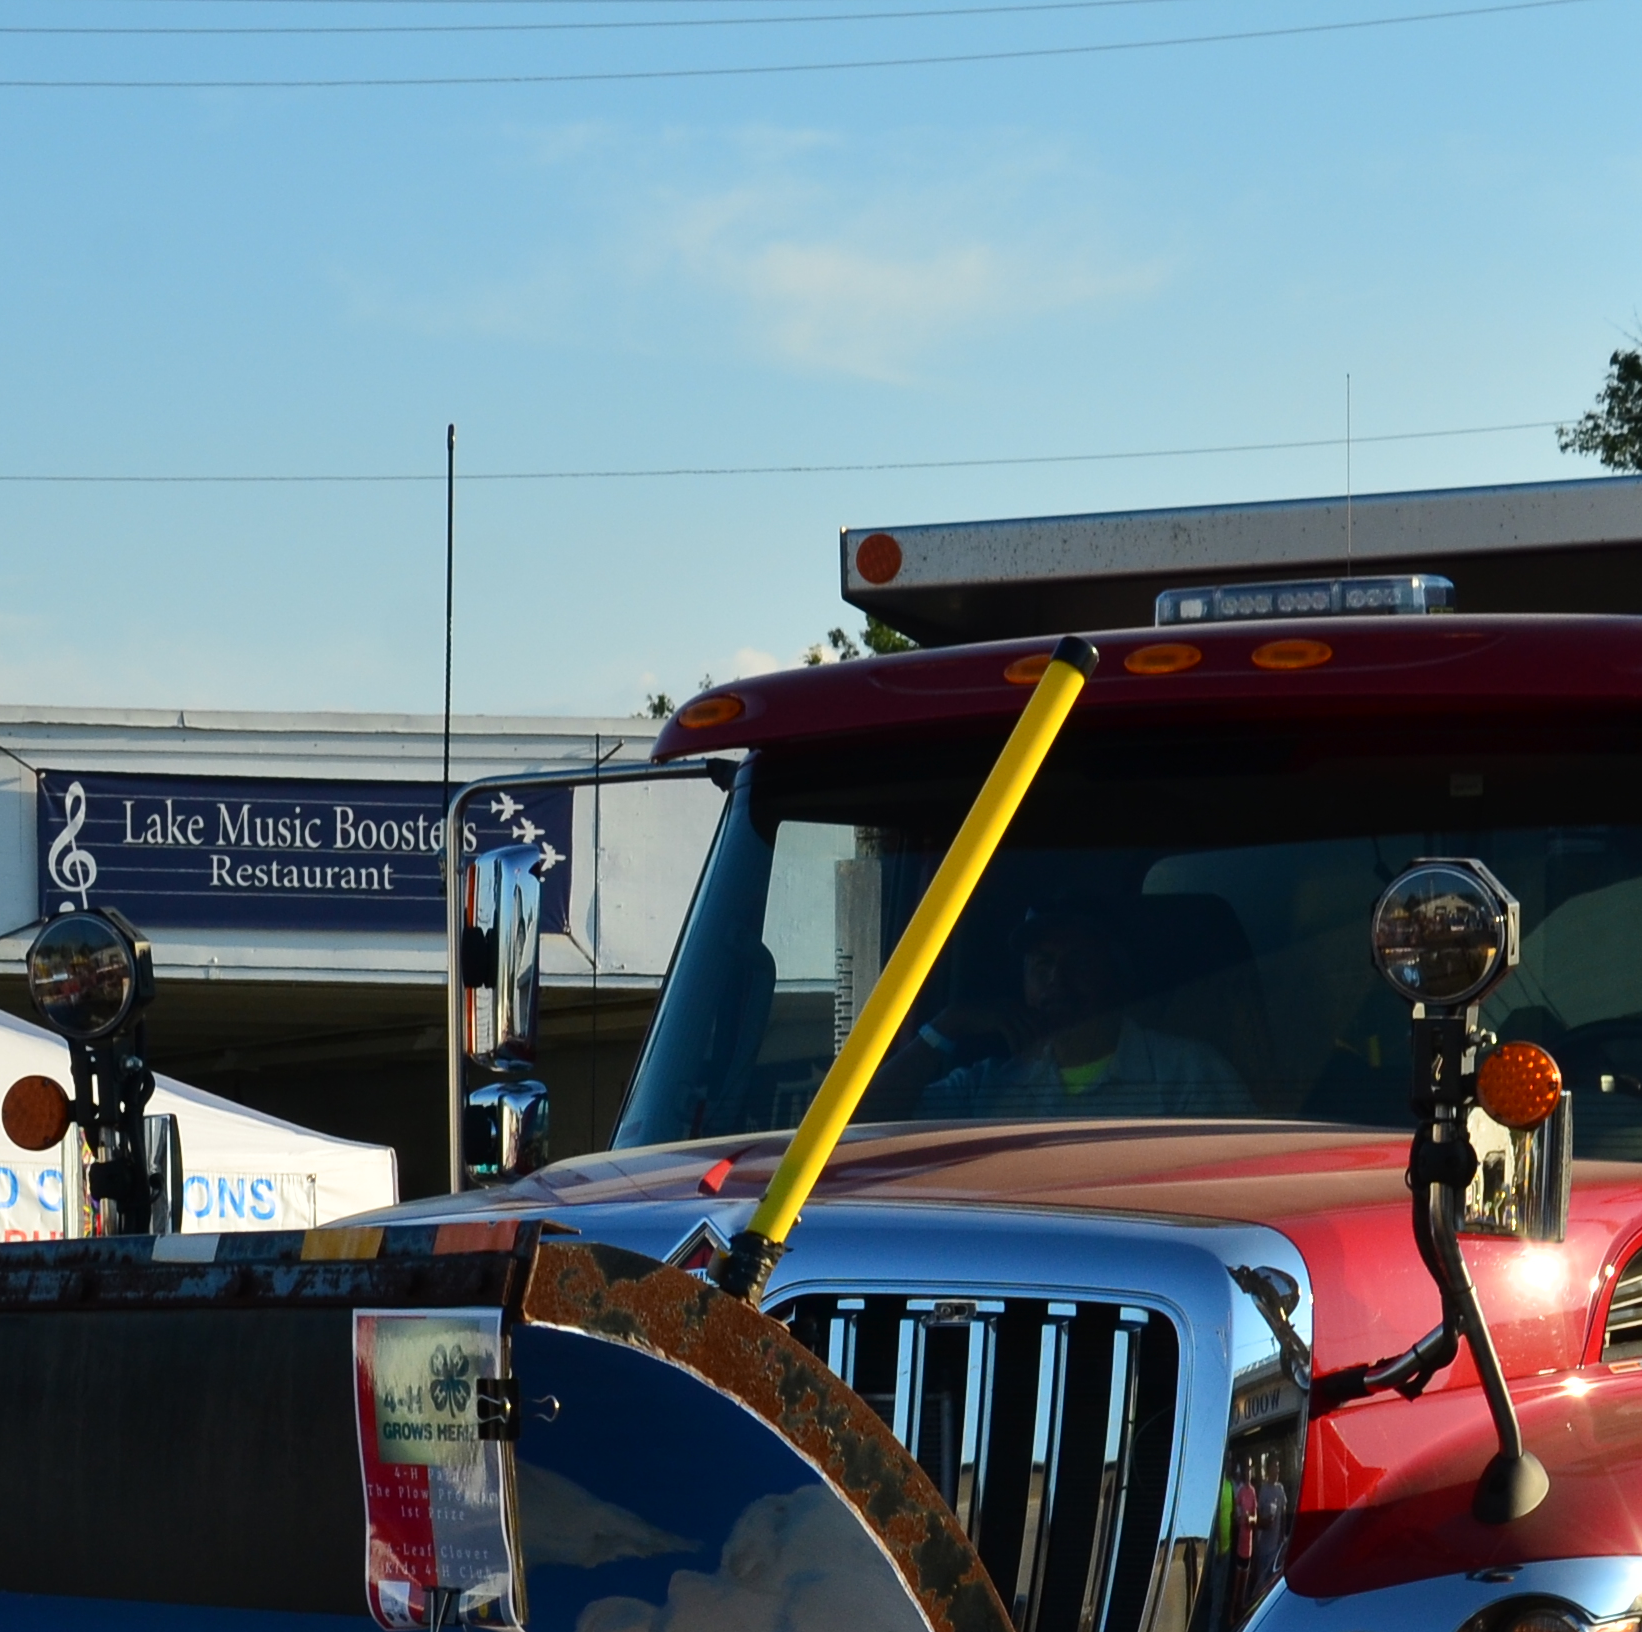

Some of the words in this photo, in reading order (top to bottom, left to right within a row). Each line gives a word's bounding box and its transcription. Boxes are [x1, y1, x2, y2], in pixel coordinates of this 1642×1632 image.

[122, 799, 204, 846] Lake
[216, 803, 323, 851] Music
[333, 806, 477, 854] Boostes
[209, 854, 395, 891] Restaurant
[37, 1168, 276, 1221] CONS
[383, 1422, 433, 1441] GROWS
[367, 1484, 390, 1498] The
[398, 1486, 430, 1499] Plow
[428, 1507, 465, 1521] Prize
[440, 1544, 489, 1560] Clover
[385, 1562, 417, 1576] Kids
